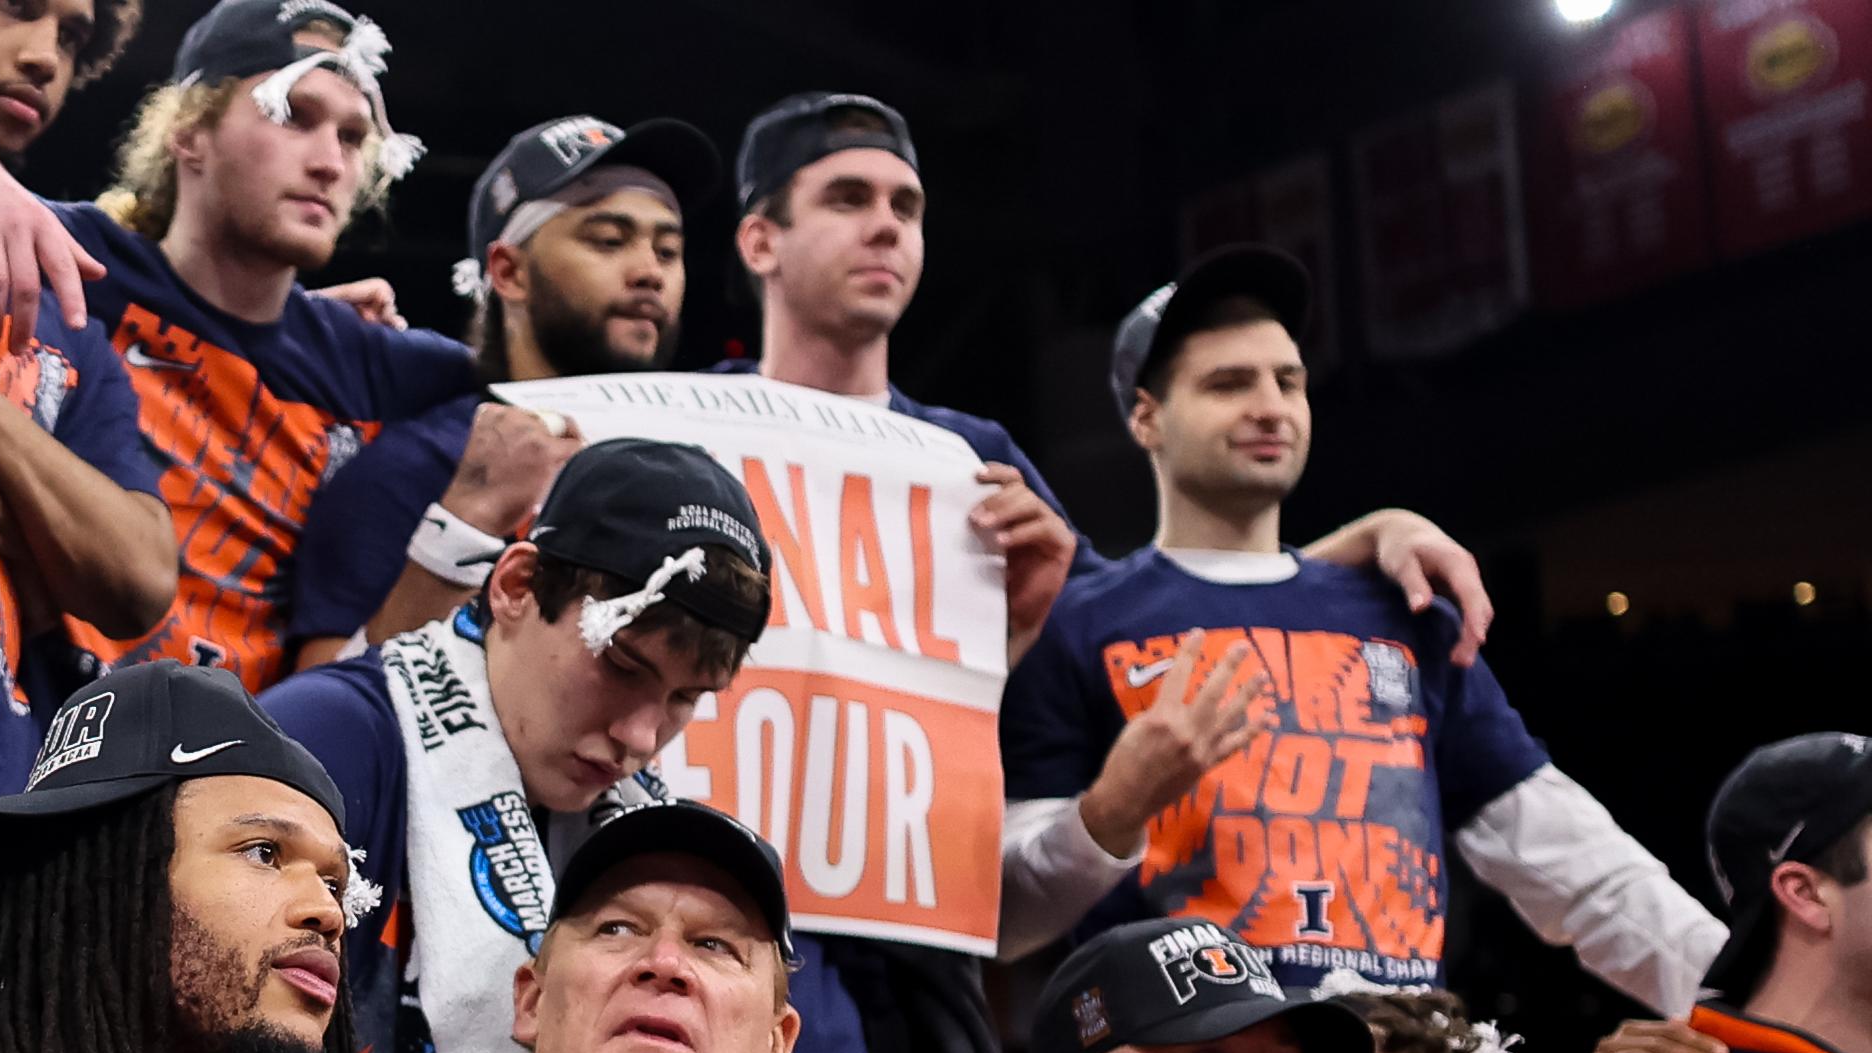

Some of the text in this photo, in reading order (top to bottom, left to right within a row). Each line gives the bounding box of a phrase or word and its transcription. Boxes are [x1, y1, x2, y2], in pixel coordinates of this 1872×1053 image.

[588, 382, 926, 448] THE DAILY ILLINI
[667, 514, 721, 532] REGIONAL
[740, 456, 960, 665] NAL
[485, 841, 548, 932] MARCH
[492, 793, 552, 918] ADNESS
[1148, 923, 1229, 964] FINAL
[1282, 944, 1384, 977] REGIONAL
